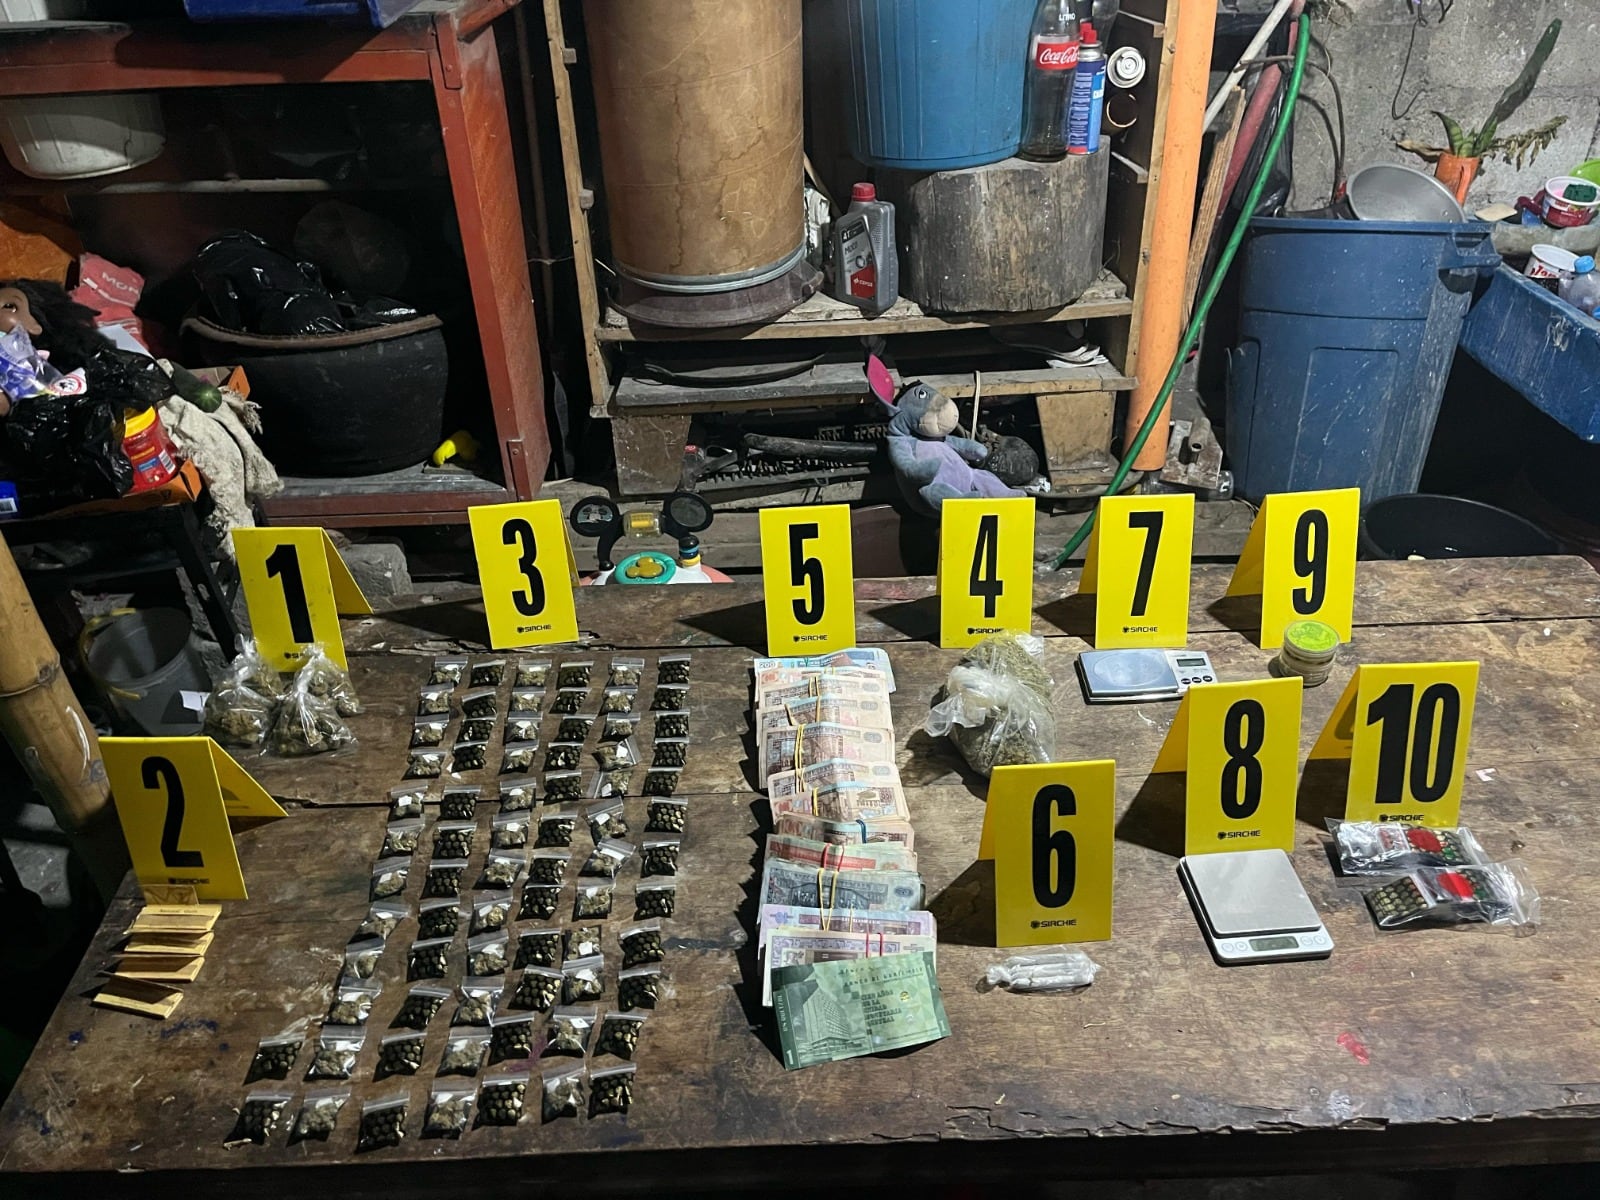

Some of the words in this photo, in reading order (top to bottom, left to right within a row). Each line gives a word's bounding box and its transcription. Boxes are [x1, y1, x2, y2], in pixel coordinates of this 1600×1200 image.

[266, 545, 314, 643] 1
[503, 519, 544, 616] 3
[789, 523, 824, 624] 5
[970, 515, 1002, 617] 4
[1129, 512, 1163, 616] 7
[1293, 510, 1328, 614] 9
[1221, 700, 1264, 819] 8
[1367, 684, 1459, 803] 10
[141, 756, 204, 868] 2
[1032, 784, 1076, 908] 6
[1227, 829, 1261, 839] SIRCHIE
[1040, 918, 1077, 928] SIRCHIE
